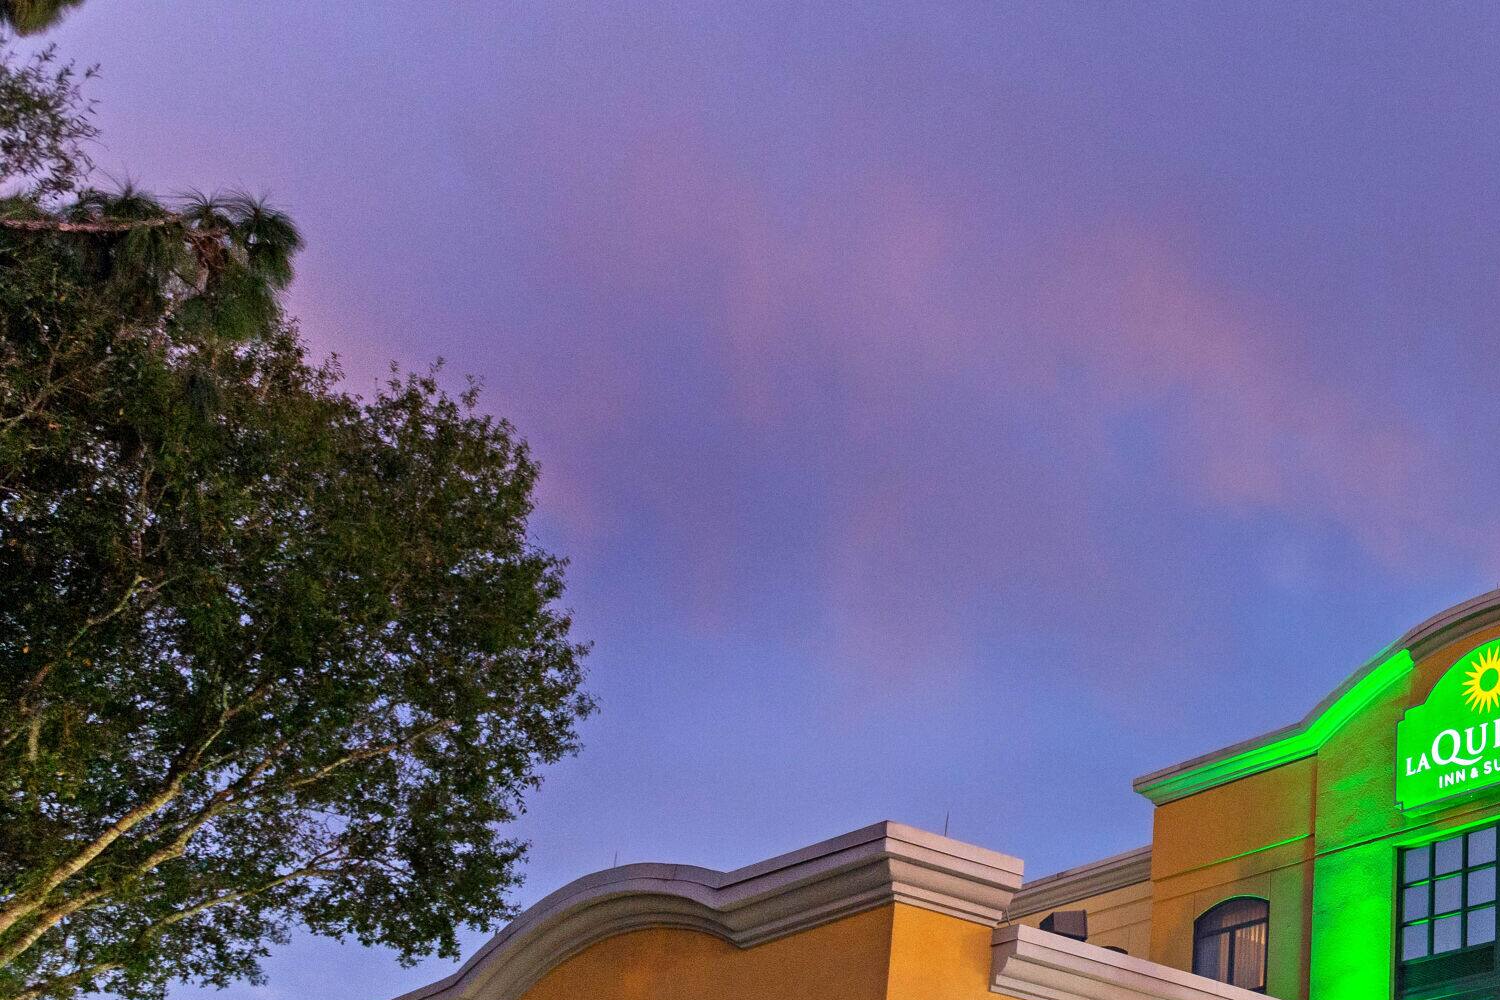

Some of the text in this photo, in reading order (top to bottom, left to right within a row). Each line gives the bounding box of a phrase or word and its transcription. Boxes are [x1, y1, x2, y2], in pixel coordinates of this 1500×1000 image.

[1406, 753, 1431, 776] LA
[1438, 768, 1466, 789] INN
[1470, 767, 1479, 779] &
